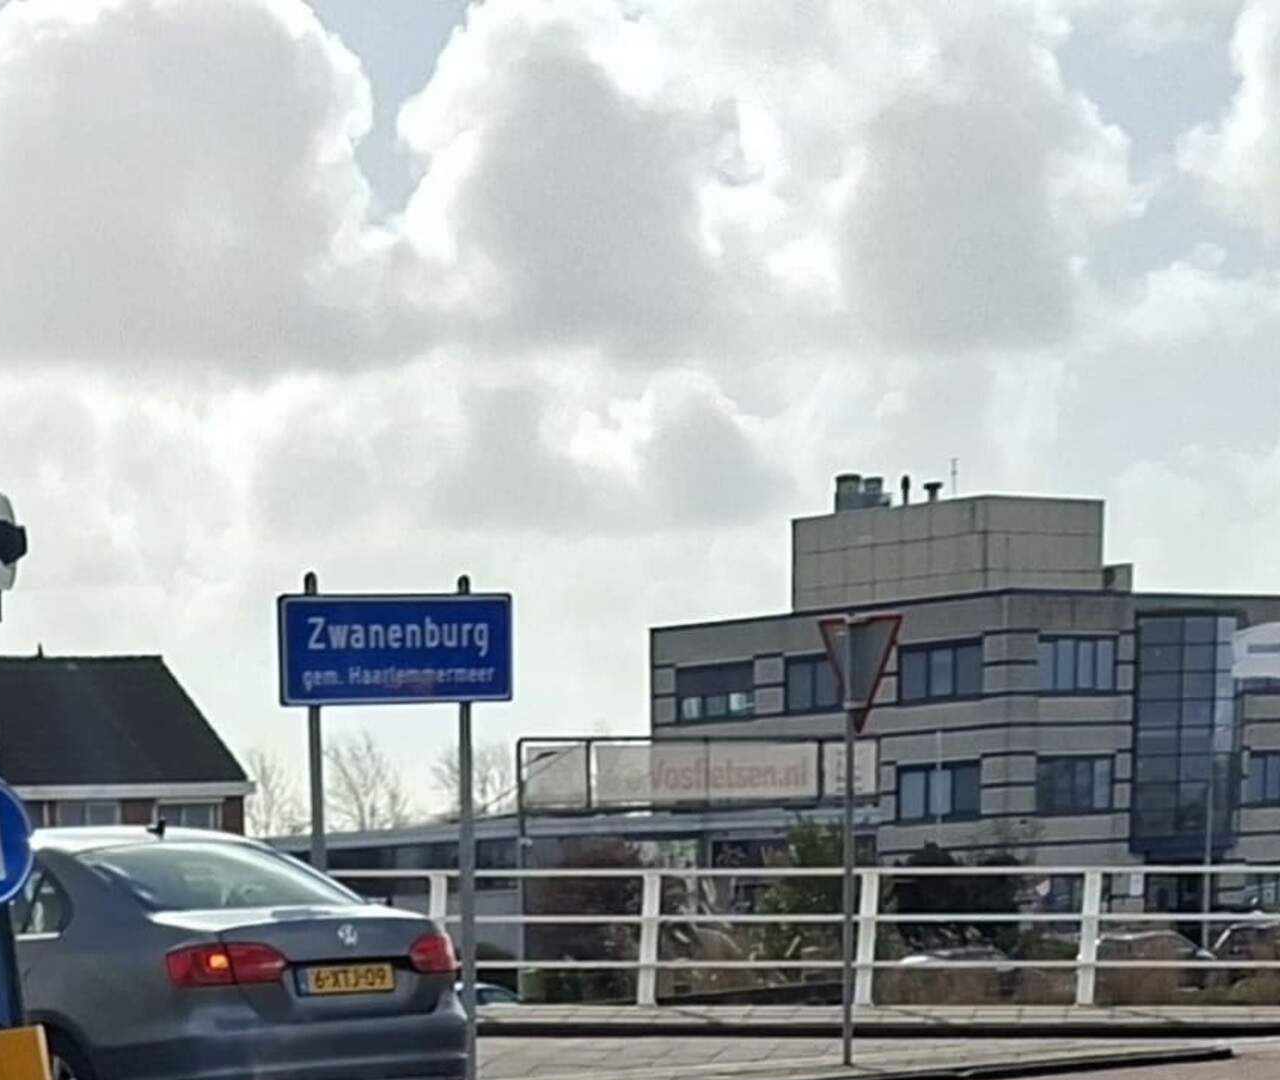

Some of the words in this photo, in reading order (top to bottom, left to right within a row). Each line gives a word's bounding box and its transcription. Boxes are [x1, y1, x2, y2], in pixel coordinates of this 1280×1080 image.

[306, 615, 489, 658] Zwanenburg
[301, 668, 344, 692] gem.
[347, 665, 497, 686] Haarlemmermeer
